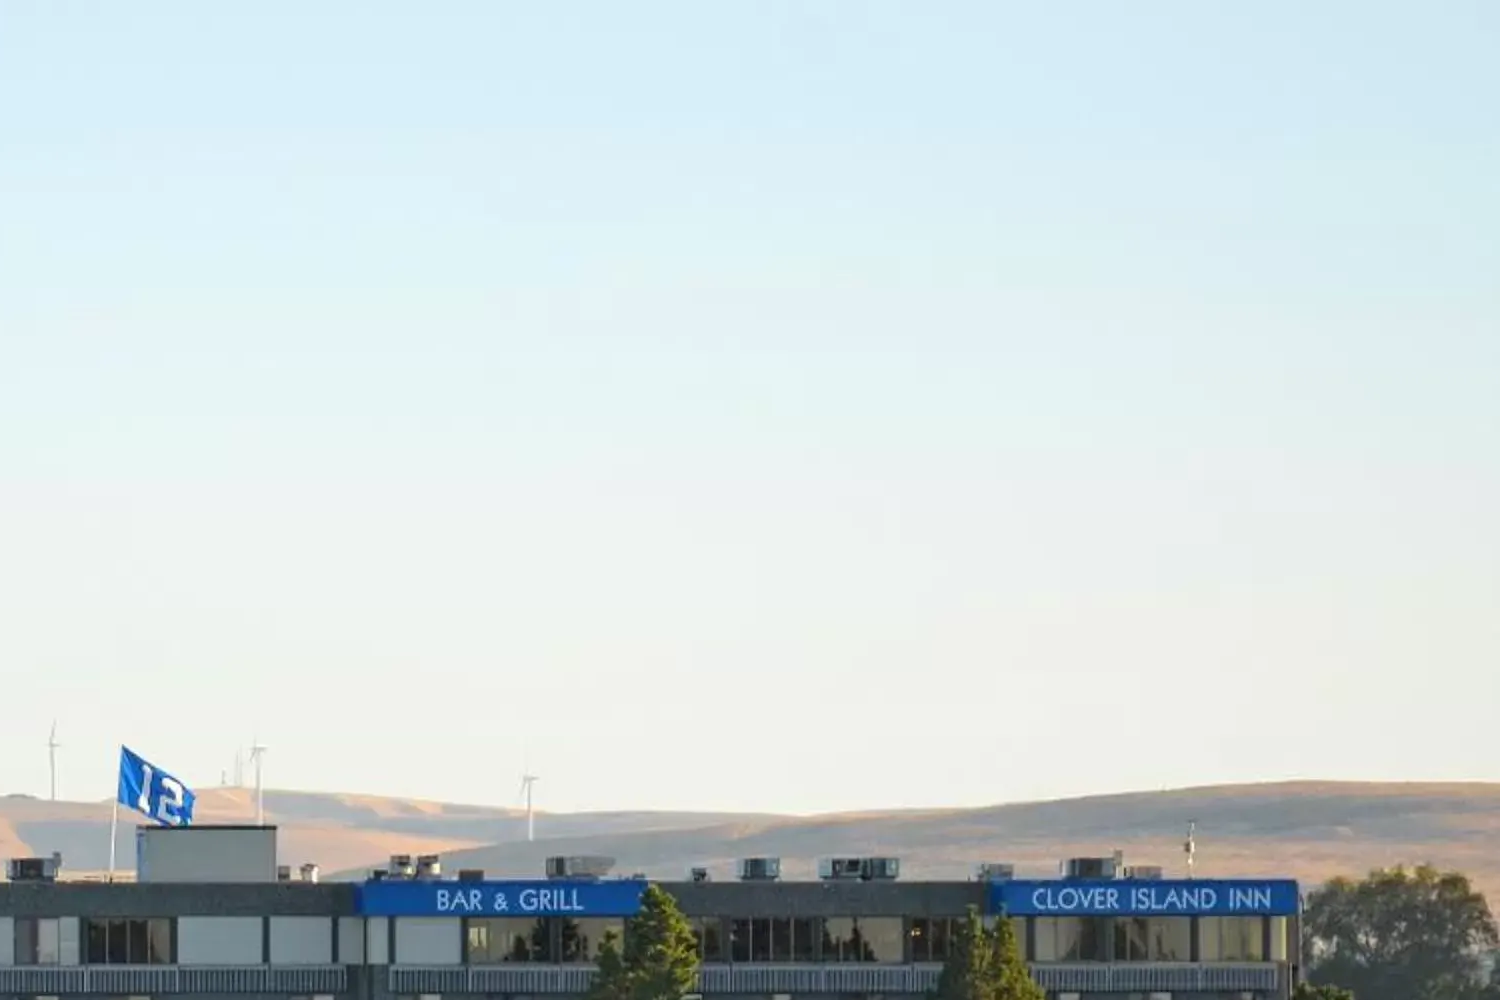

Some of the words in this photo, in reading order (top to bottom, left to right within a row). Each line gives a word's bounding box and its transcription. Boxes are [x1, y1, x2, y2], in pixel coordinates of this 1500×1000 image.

[138, 763, 183, 823] 12
[436, 888, 483, 911] BAR
[493, 891, 509, 911] &
[519, 888, 585, 911] GRILL
[1032, 888, 1119, 910] CLOVER
[1131, 888, 1217, 910] ISLAND
[1229, 887, 1271, 910] INN
